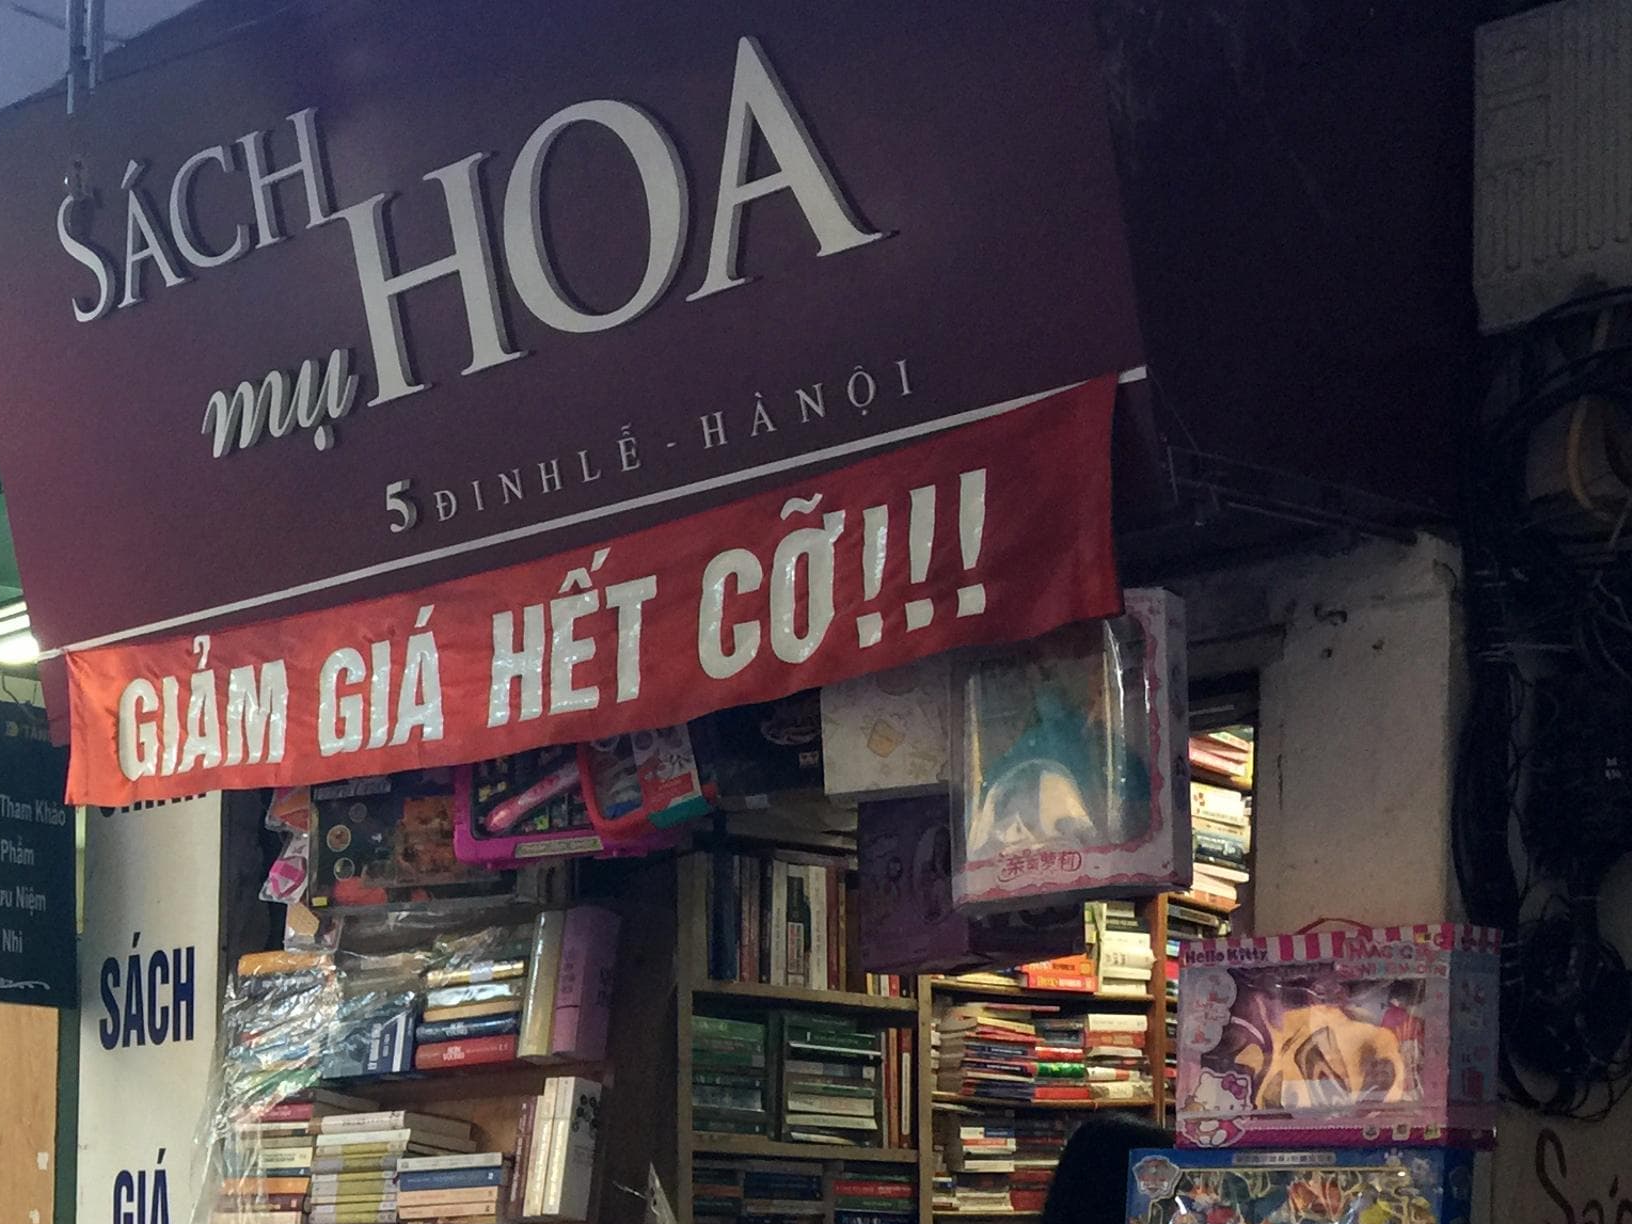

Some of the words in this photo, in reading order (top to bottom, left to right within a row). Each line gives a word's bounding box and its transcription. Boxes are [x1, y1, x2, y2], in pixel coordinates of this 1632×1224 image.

[57, 105, 337, 323] SÁCH
[201, 347, 358, 459] mụ
[334, 34, 898, 409] HOA
[386, 478, 418, 534] 5
[118, 635, 289, 783] GIẢM
[317, 605, 445, 754] GIÁ
[487, 547, 657, 728] HẾT
[35, 799, 67, 827] Khảo
[1, 927, 24, 954] Nhi
[15, 885, 47, 916] Niệm
[99, 932, 196, 1051] SÁCH
